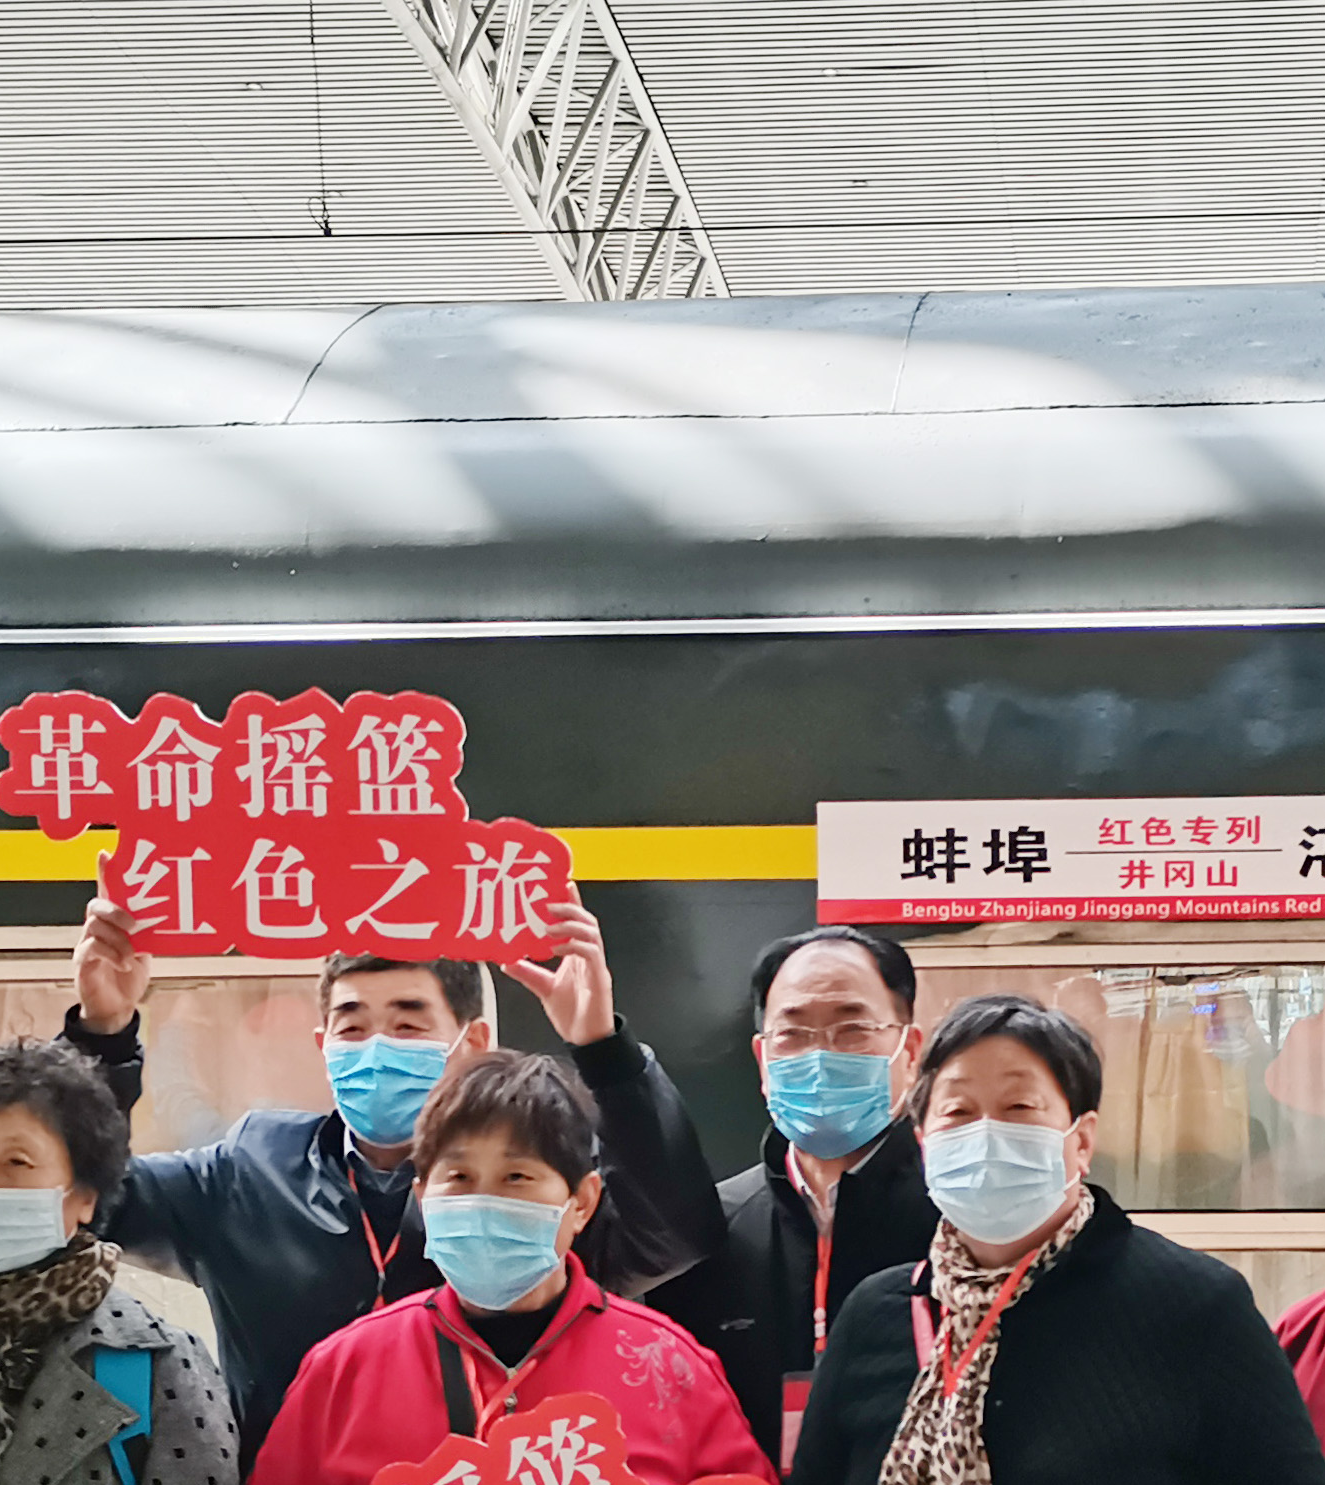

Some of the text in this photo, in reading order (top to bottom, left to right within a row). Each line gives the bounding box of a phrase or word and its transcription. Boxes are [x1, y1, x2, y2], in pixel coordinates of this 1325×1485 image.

[14, 712, 447, 822] 革命摇篮
[1097, 815, 1261, 846] 红色专列
[900, 825, 1051, 884] 蚌埠
[1118, 859, 1239, 890] 井冈山
[121, 838, 553, 944] 红色之旅
[902, 902, 975, 921] Bengbu
[980, 900, 1077, 920] Zhanjiang
[1081, 899, 1171, 918] Jinggang
[1175, 898, 1280, 915] Mountains
[1285, 896, 1322, 913] Red
